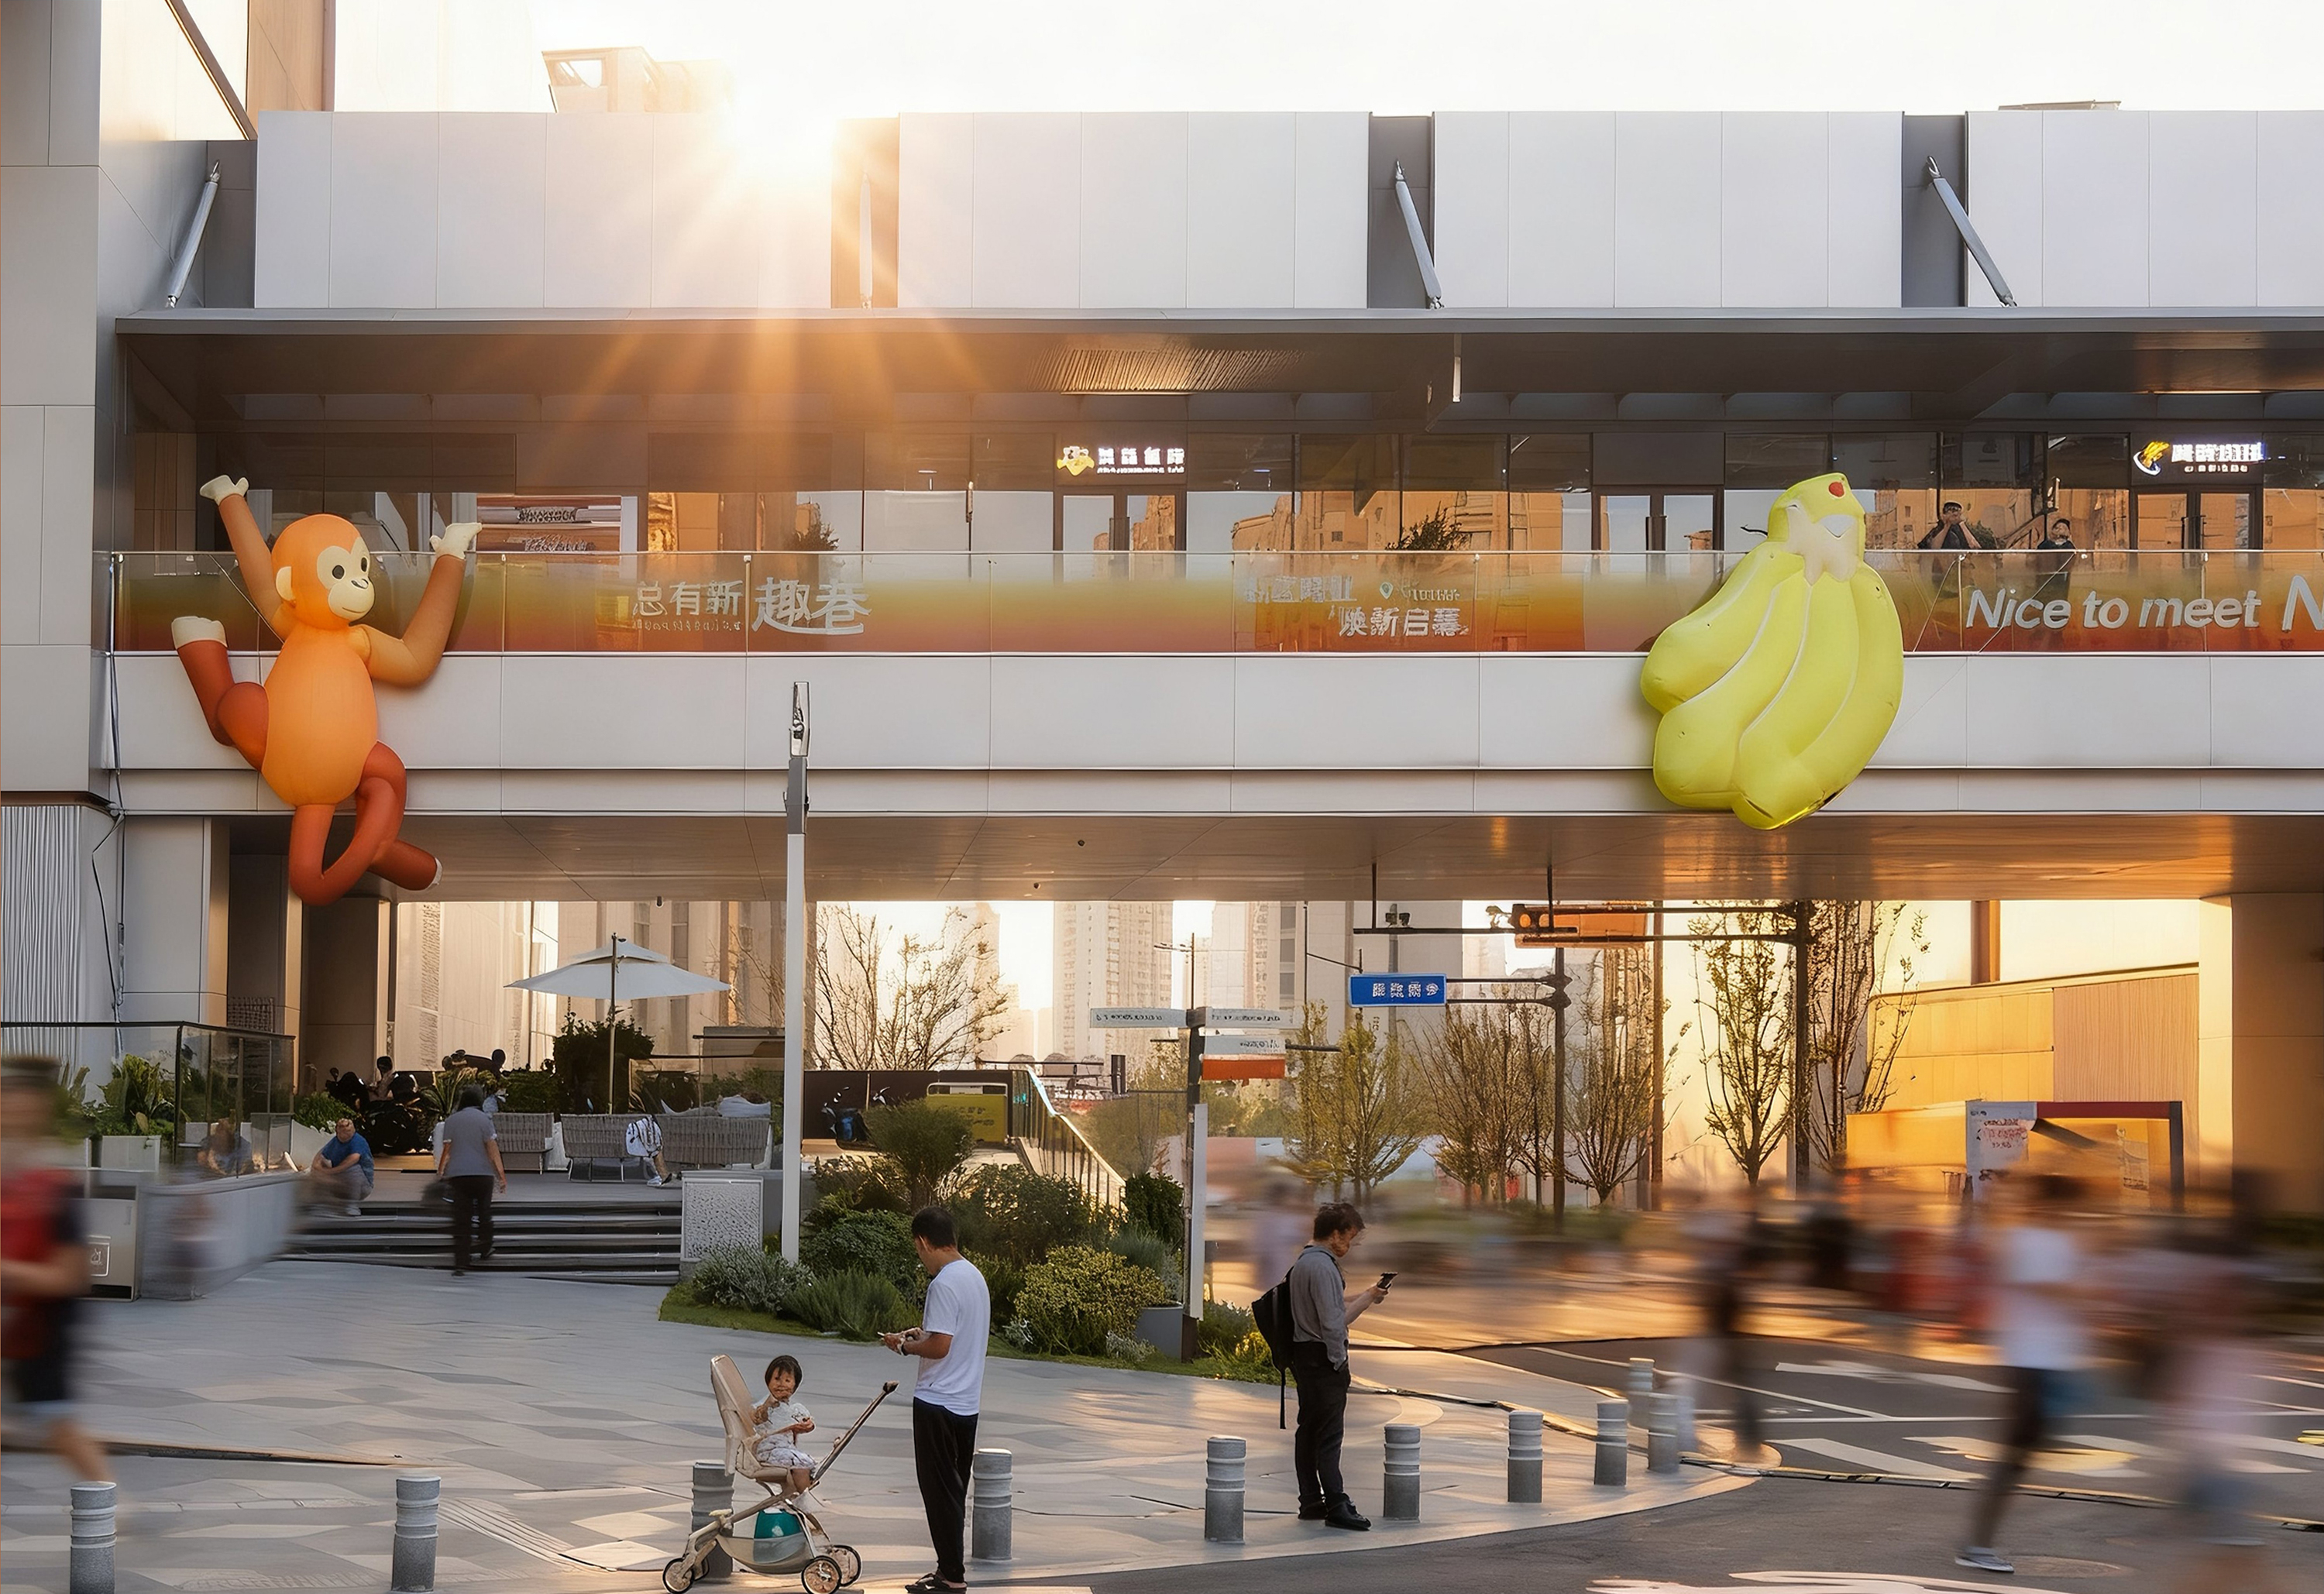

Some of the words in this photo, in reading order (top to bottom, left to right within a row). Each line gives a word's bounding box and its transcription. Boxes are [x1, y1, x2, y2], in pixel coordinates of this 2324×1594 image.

[1966, 588, 2071, 628] Nice
[2082, 590, 2130, 628] to
[2138, 590, 2261, 628] meet
